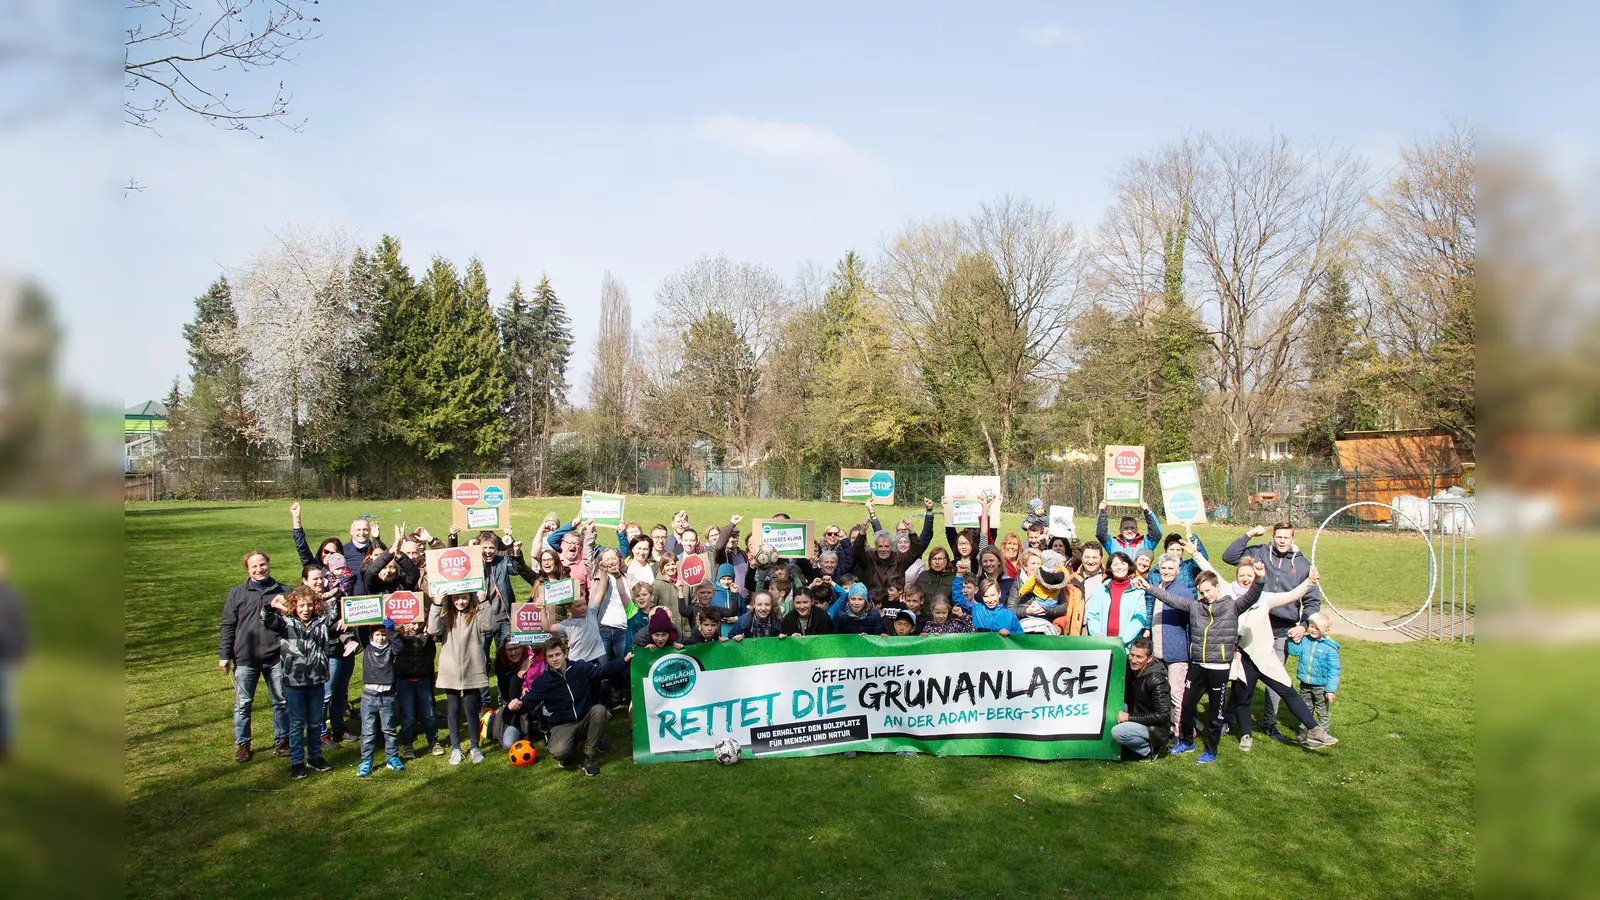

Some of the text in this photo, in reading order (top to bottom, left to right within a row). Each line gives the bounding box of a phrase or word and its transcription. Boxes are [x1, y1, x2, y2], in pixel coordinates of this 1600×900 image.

[1118, 456, 1138, 465] STOP
[872, 482, 892, 490] STOP
[441, 556, 466, 568] STOP
[684, 565, 702, 578] STOP
[388, 599, 415, 610] STOP
[654, 670, 695, 682] GRÜNFLÄCHE
[812, 664, 905, 683] ÖFFENTLICHE
[859, 665, 1098, 712] GRÜNANLAGE
[657, 685, 846, 741] RETTET DIE
[884, 704, 1089, 727] AN DER ADAM-BERG-STRASSE
[773, 726, 806, 737] ERHALTET
[808, 724, 822, 733] DEN
[823, 719, 861, 730] BOLZPLATZ
[769, 730, 850, 747] FÜR MENSCH UND NATUR
